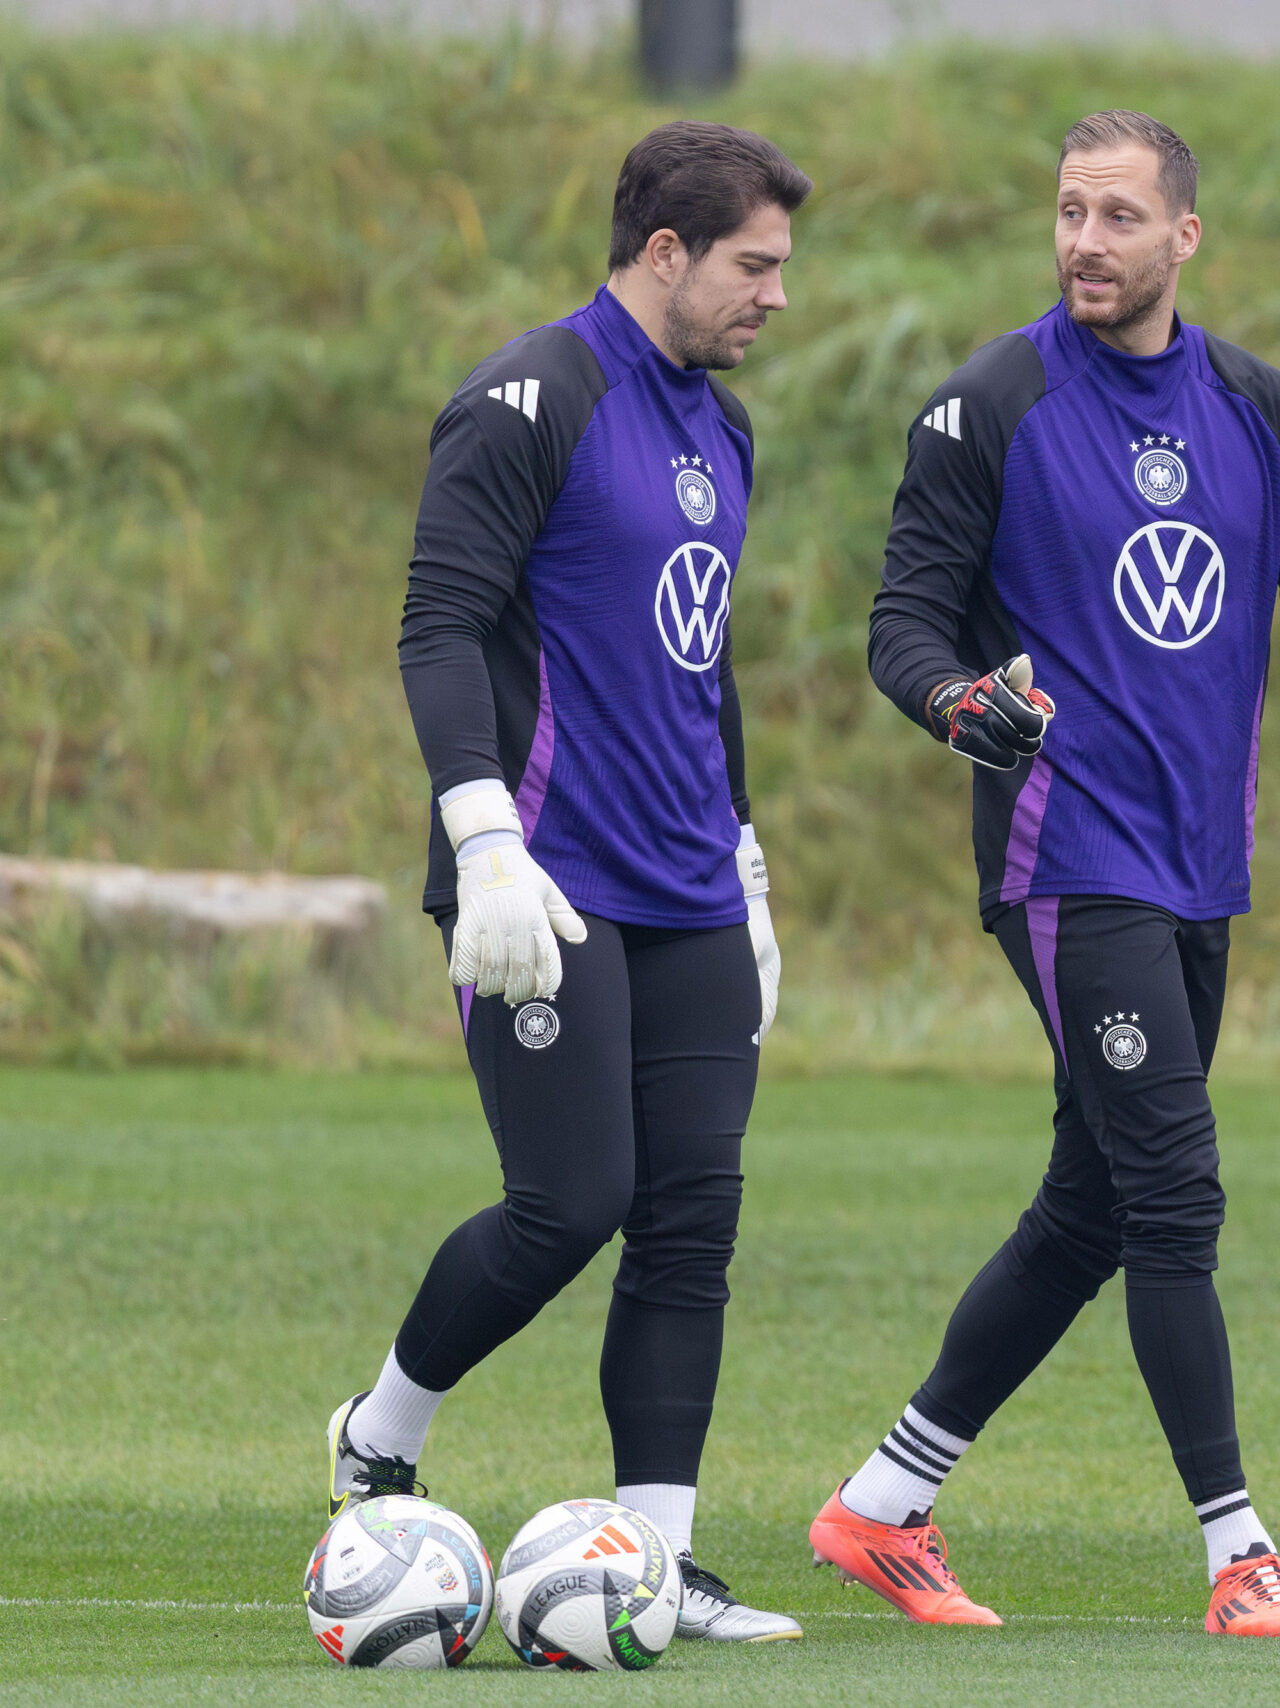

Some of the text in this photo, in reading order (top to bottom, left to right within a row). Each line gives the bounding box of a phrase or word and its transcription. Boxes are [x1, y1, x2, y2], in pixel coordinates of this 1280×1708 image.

[664, 546, 727, 661] VW
[1121, 524, 1221, 637] VW
[440, 1529, 481, 1591] LEAGUE
[529, 1574, 588, 1615] LEAGUE
